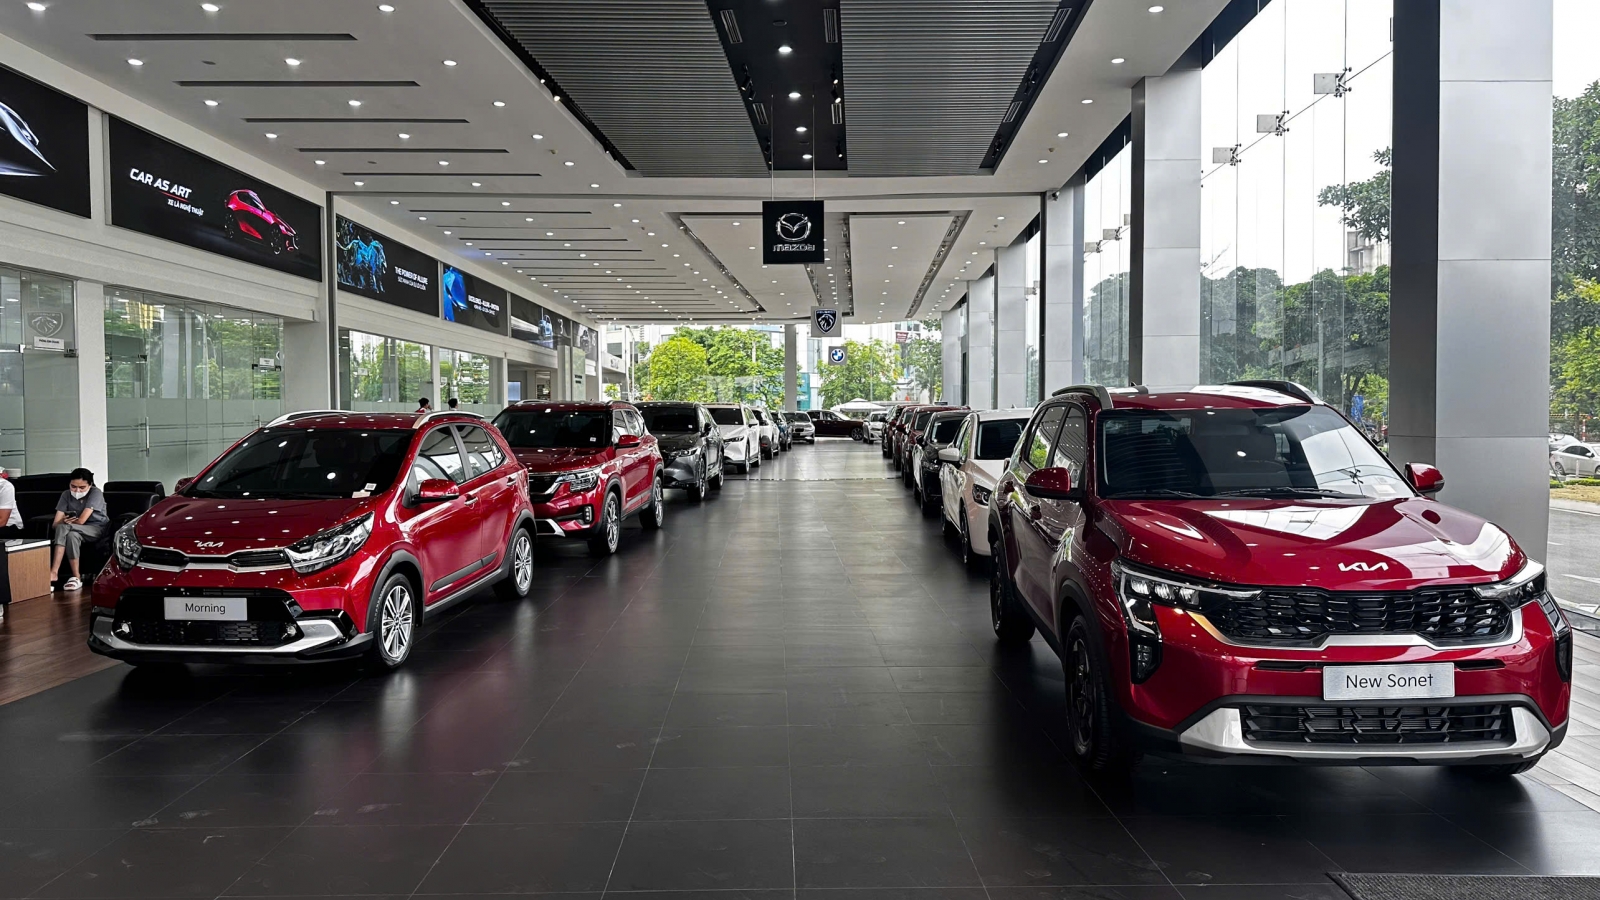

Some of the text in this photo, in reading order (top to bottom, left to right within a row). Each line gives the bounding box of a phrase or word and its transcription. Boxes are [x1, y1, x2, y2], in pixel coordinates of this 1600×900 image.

[130, 168, 192, 198] CAR AS ART
[1338, 562, 1389, 572] KIA
[185, 603, 226, 615] Morning
[1346, 673, 1434, 689] New Sonet
